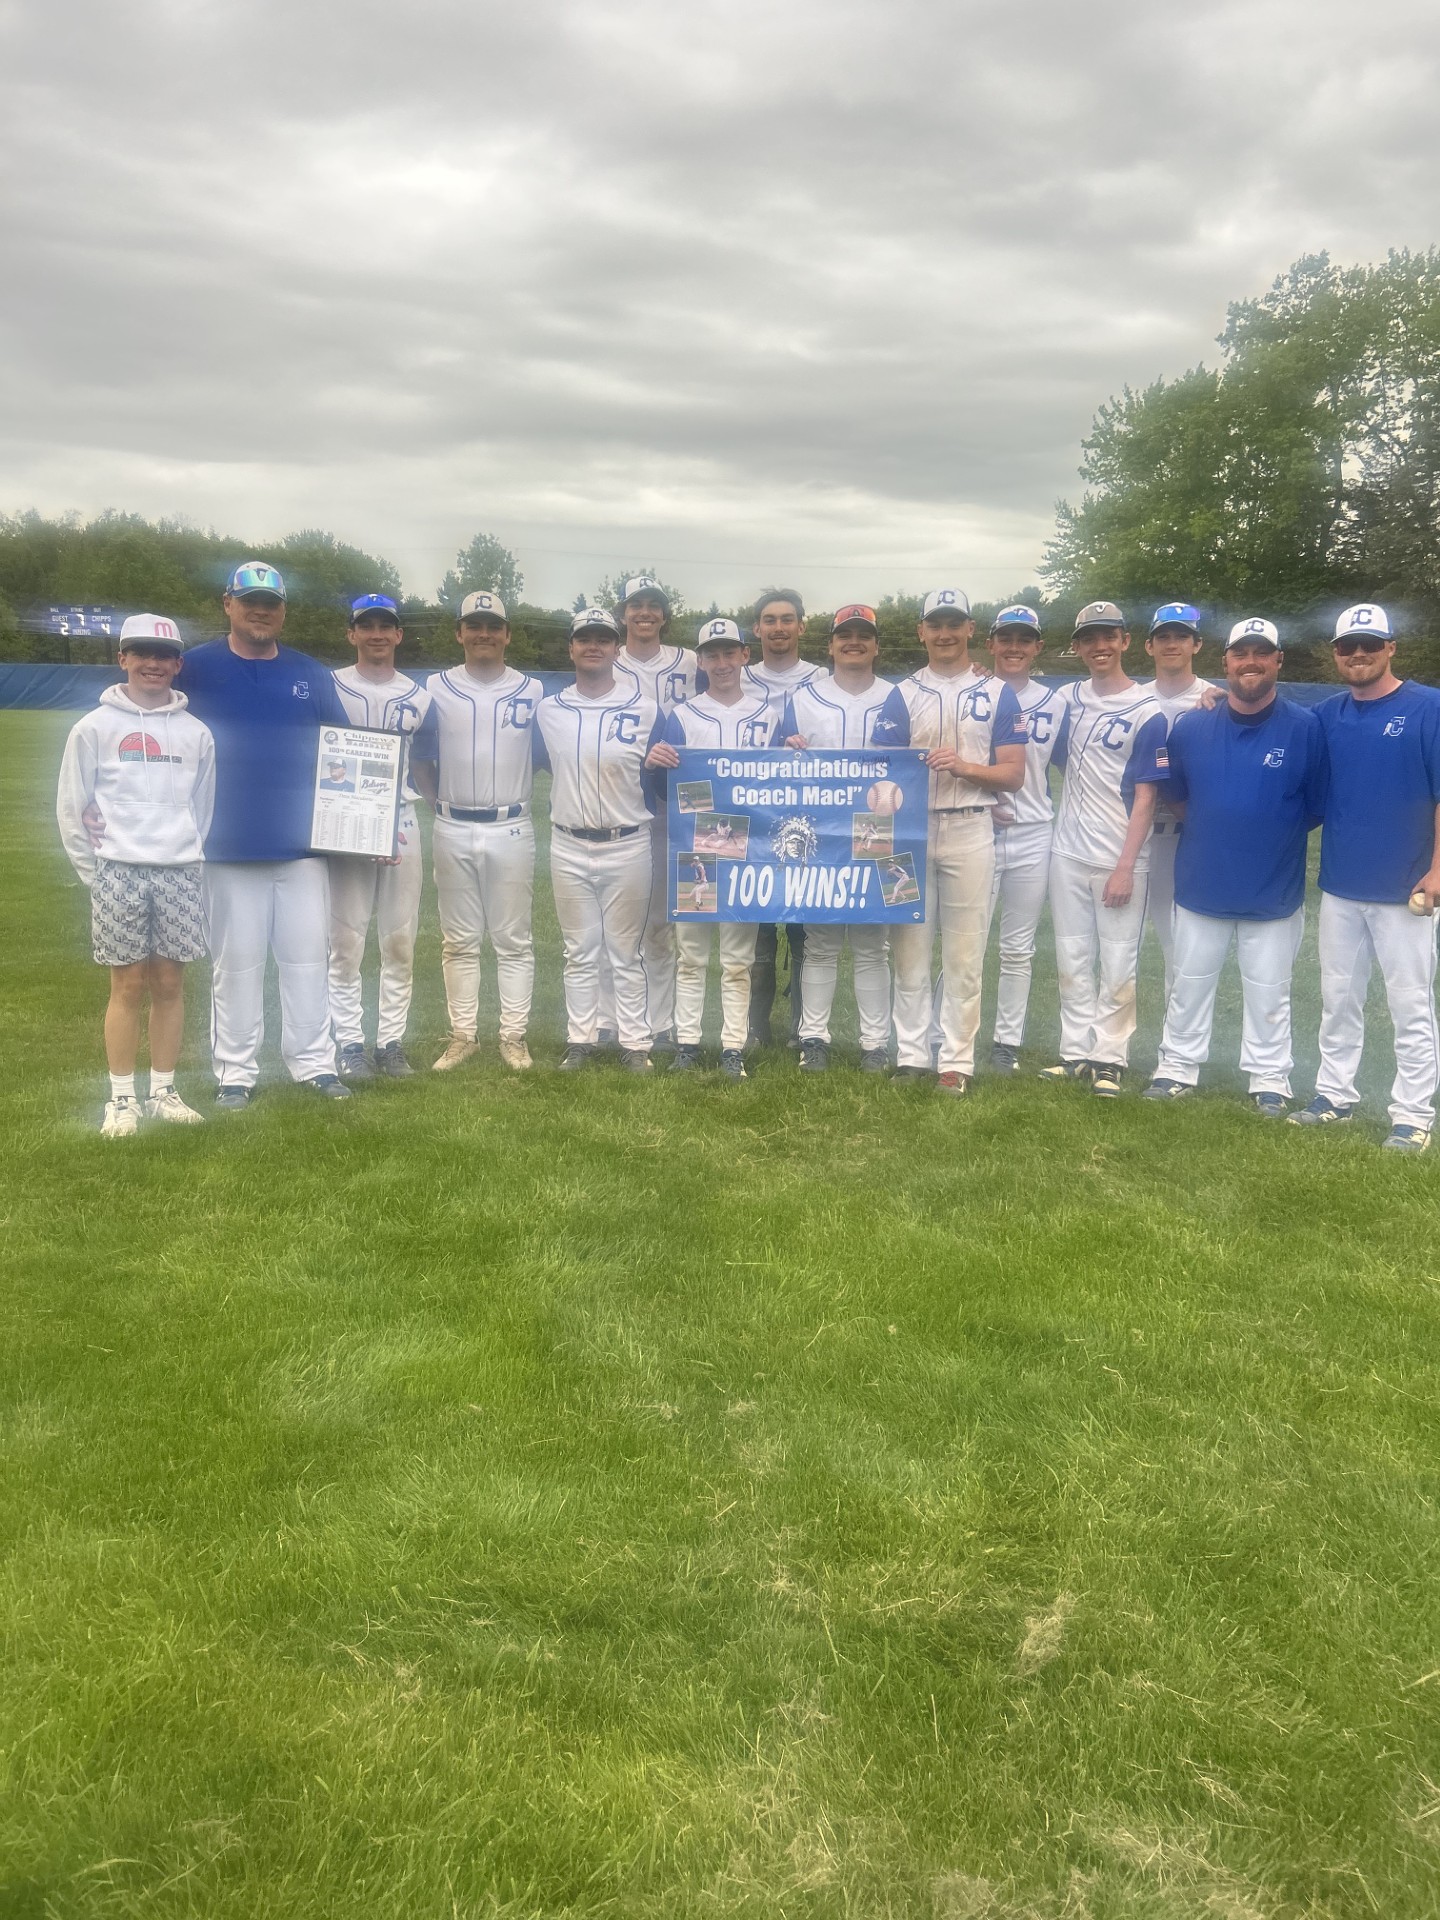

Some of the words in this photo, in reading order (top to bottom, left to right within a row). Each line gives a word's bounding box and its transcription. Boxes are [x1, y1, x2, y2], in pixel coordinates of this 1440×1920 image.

[60, 622, 69, 635] 2
[101, 623, 110, 634] 4
[671, 673, 687, 704] C
[511, 698, 533, 728] C
[970, 691, 991, 722] C
[616, 712, 641, 744] C
[1032, 712, 1053, 744] C
[1102, 717, 1133, 750] C
[346, 748, 372, 758] CAREER
[374, 752, 389, 760] WIN
[707, 757, 888, 780] “Congratulations
[732, 785, 799, 806] Coach
[802, 785, 863, 806] Mac!”
[727, 865, 774, 907] 100
[784, 865, 872, 909] WINS!!
